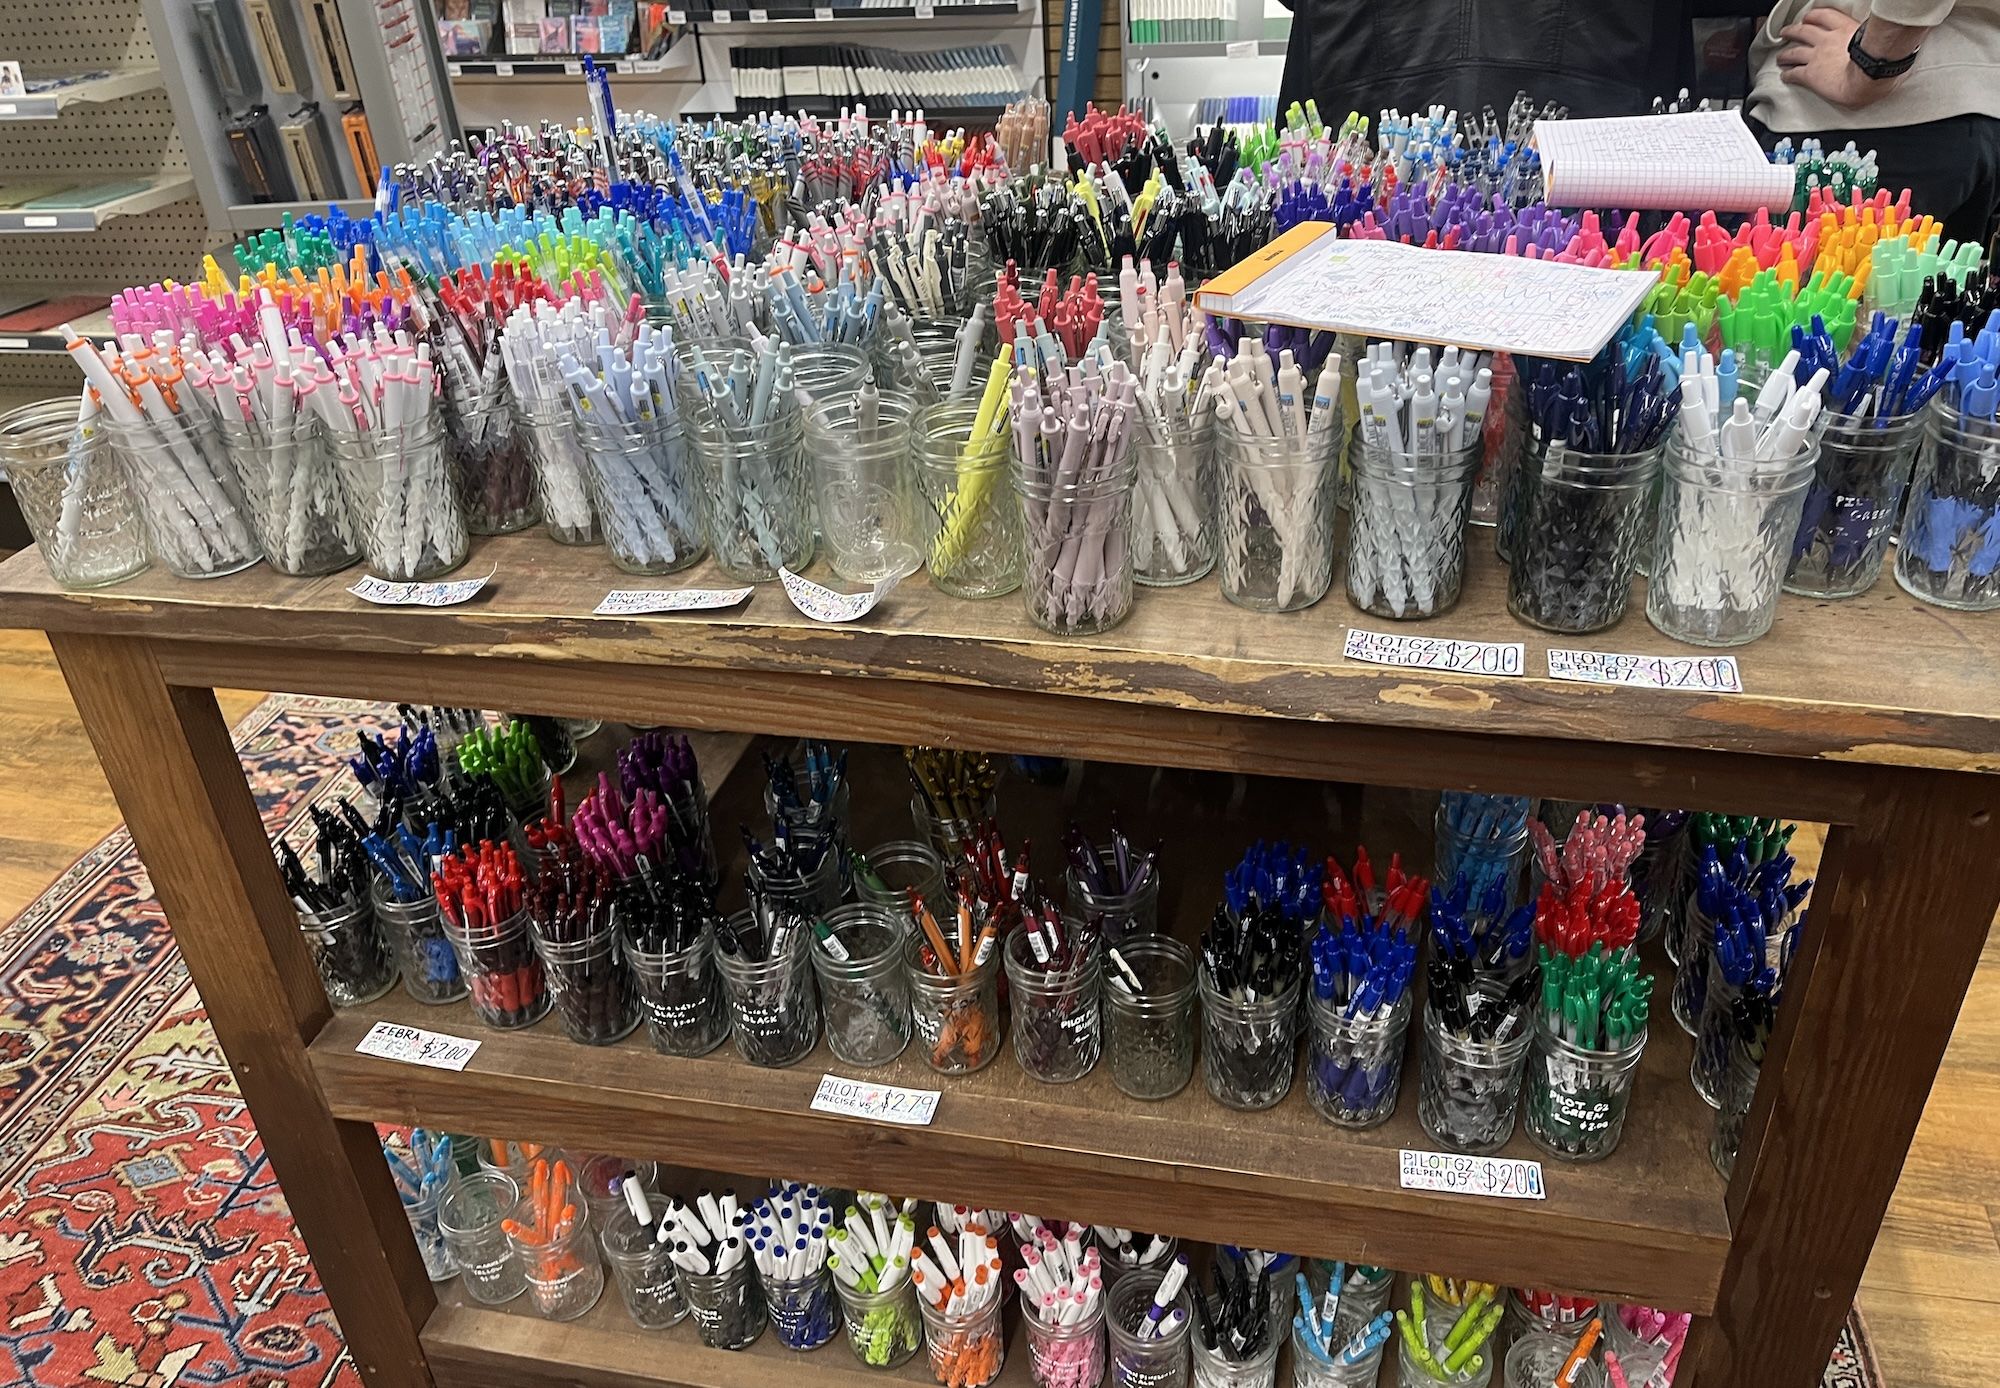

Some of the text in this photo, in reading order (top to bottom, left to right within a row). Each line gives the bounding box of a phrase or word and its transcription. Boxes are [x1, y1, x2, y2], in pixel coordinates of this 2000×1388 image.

[1066, 0, 1079, 61] LEUCHTTURM
[1350, 630, 1436, 651] PILOT G2
[1374, 644, 1400, 655] PEN
[1550, 650, 1644, 668] PILOT G2
[742, 1013, 778, 1024] BLACK
[375, 1025, 420, 1040] ZEBRA
[819, 1079, 863, 1098] PILOT
[816, 1092, 857, 1107] PRECISE
[1549, 1089, 1610, 1113] PILOT G2
[1561, 1105, 1605, 1121] GREEN
[1403, 1152, 1475, 1172] PILOT G2
